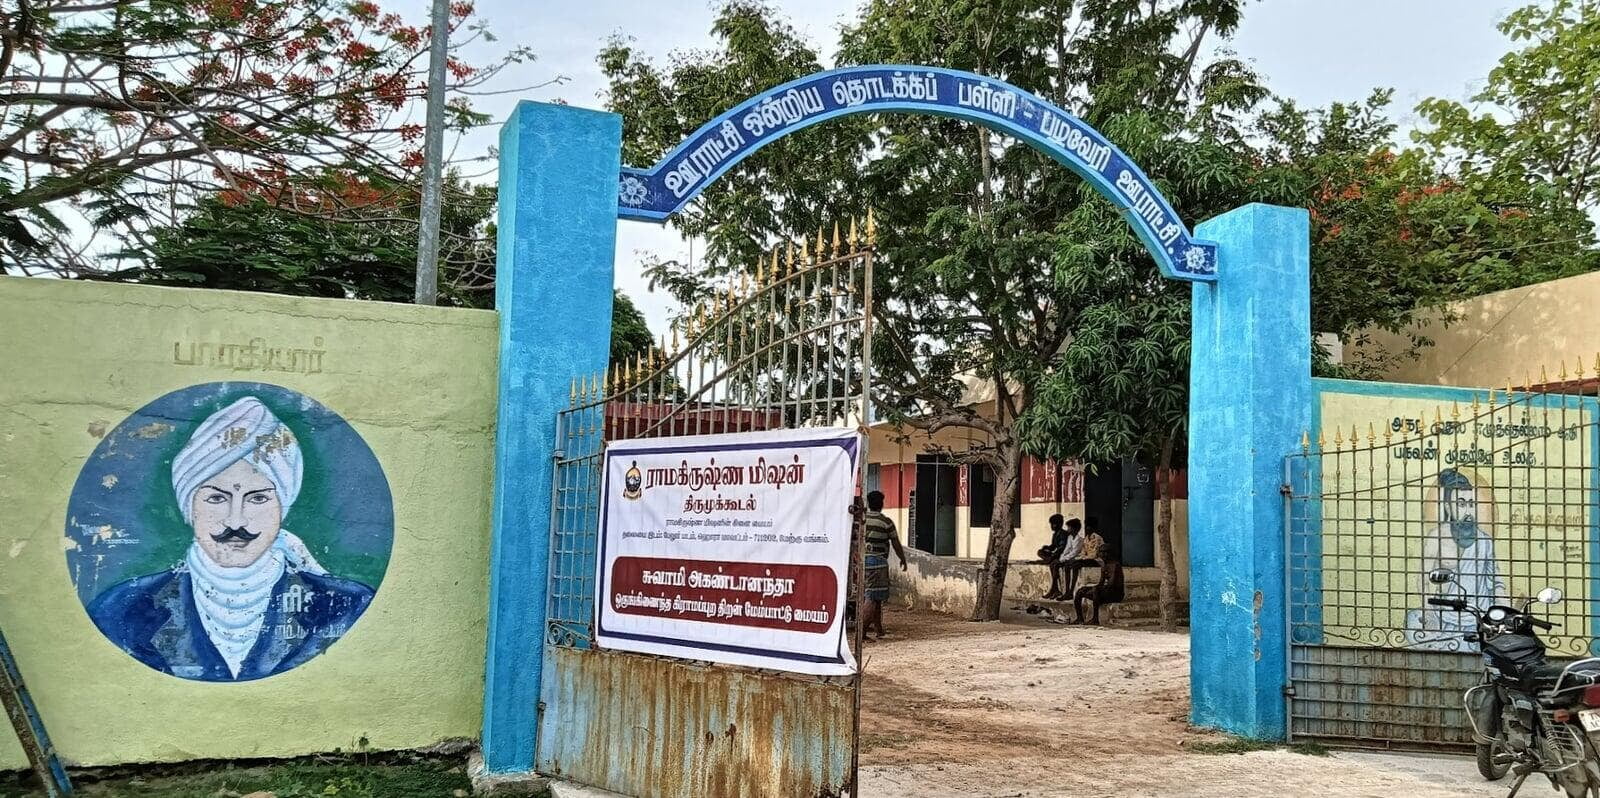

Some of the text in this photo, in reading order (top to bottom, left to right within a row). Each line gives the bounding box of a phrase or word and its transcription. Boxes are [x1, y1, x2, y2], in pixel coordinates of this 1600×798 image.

[664, 120, 745, 199] ஊராட்சி
[743, 87, 825, 137] ஒன்றிய
[832, 72, 938, 107] தொடக்கப்
[958, 82, 1016, 119] பள்ளி
[174, 336, 326, 376] பாரதியார்
[645, 454, 805, 491] ராமகிருஷ்ண மிஷன்
[683, 494, 757, 514] திருமுக்கூடல்
[642, 566, 795, 597] சுவாமி அகண்டானந்தா
[615, 590, 829, 624] ஒருங்கிணைந்த கிராமப்புற திறன் மேம்பாட்டு மையம்
